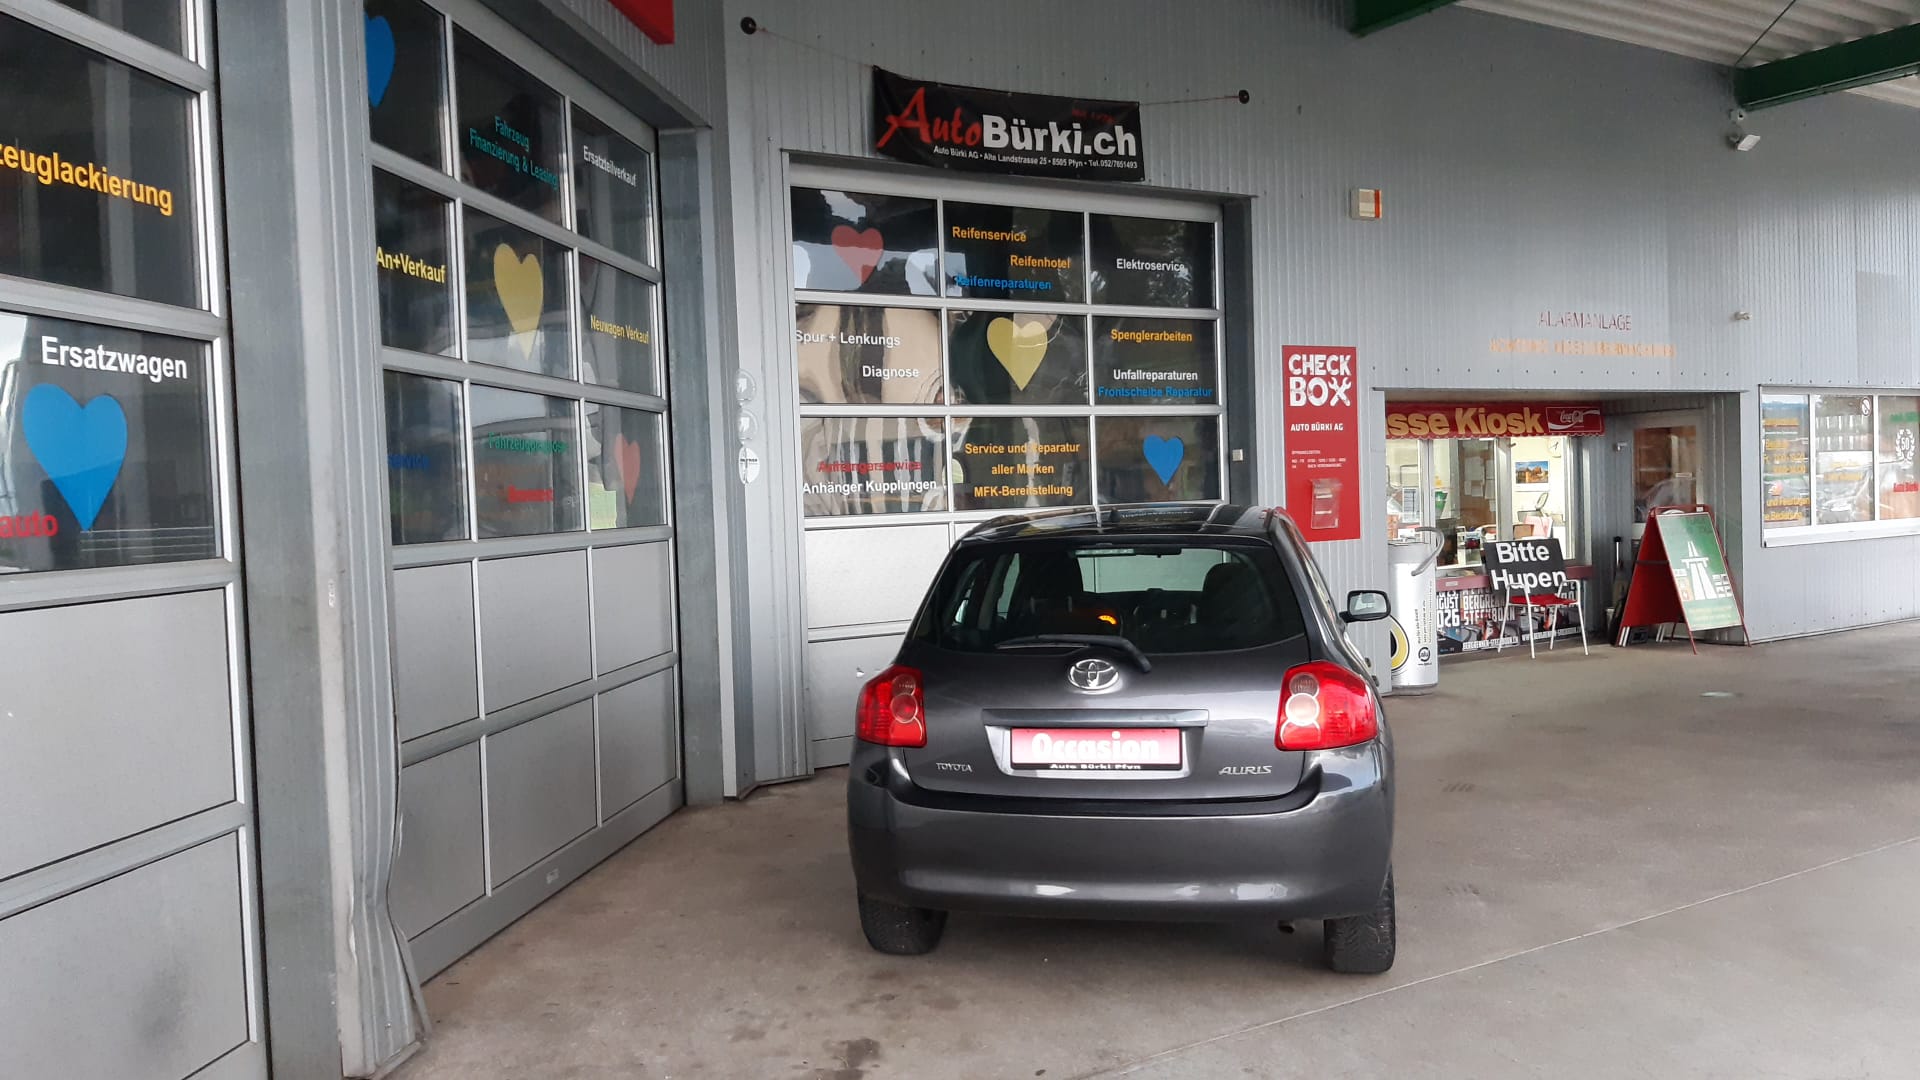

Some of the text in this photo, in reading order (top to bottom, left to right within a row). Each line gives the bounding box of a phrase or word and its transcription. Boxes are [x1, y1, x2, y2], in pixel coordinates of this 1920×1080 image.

[494, 115, 530, 152] Fahrzeug
[469, 129, 520, 173] Finanzierung
[933, 145, 950, 157] Auto
[950, 148, 967, 159] Bürki
[968, 150, 980, 160] AG
[997, 153, 1039, 165] Landstrasse
[1039, 156, 1048, 165] 25
[583, 145, 637, 188] Ersatzteilverkauf
[952, 226, 1028, 243] Reifenservice
[375, 246, 447, 284] An+Verkauf
[1010, 254, 1072, 269] Reifenhotel
[1116, 258, 1186, 272] Elektroservice
[590, 314, 625, 341] Neuwagen
[1539, 310, 1632, 331] ALARMANLAGE
[795, 329, 826, 345] Spur
[840, 332, 901, 349] Lenkungs
[1110, 329, 1193, 343] Spenglerarbeiten
[41, 335, 188, 383] Ersatzwagen
[1288, 354, 1352, 376] CHECK
[862, 365, 920, 380] Diagnose
[1113, 368, 1199, 383] Unfallreparaturen
[1289, 376, 1352, 407] BOX
[1290, 421, 1344, 432] AUTO BÜRKI AG
[1385, 406, 1545, 436] sse Kiosk
[964, 442, 1006, 455] Service
[1007, 442, 1026, 454] und
[991, 463, 1014, 475] aller
[802, 478, 937, 496] Anhänger Kupplungen
[974, 484, 1074, 499] MFK-Bereitstellung
[1495, 542, 1550, 564] Bitte
[1490, 568, 1567, 595] Hupen
[1031, 731, 1161, 760] Occasion
[935, 762, 973, 773] TOYOTA
[1219, 765, 1273, 775] AURIS
